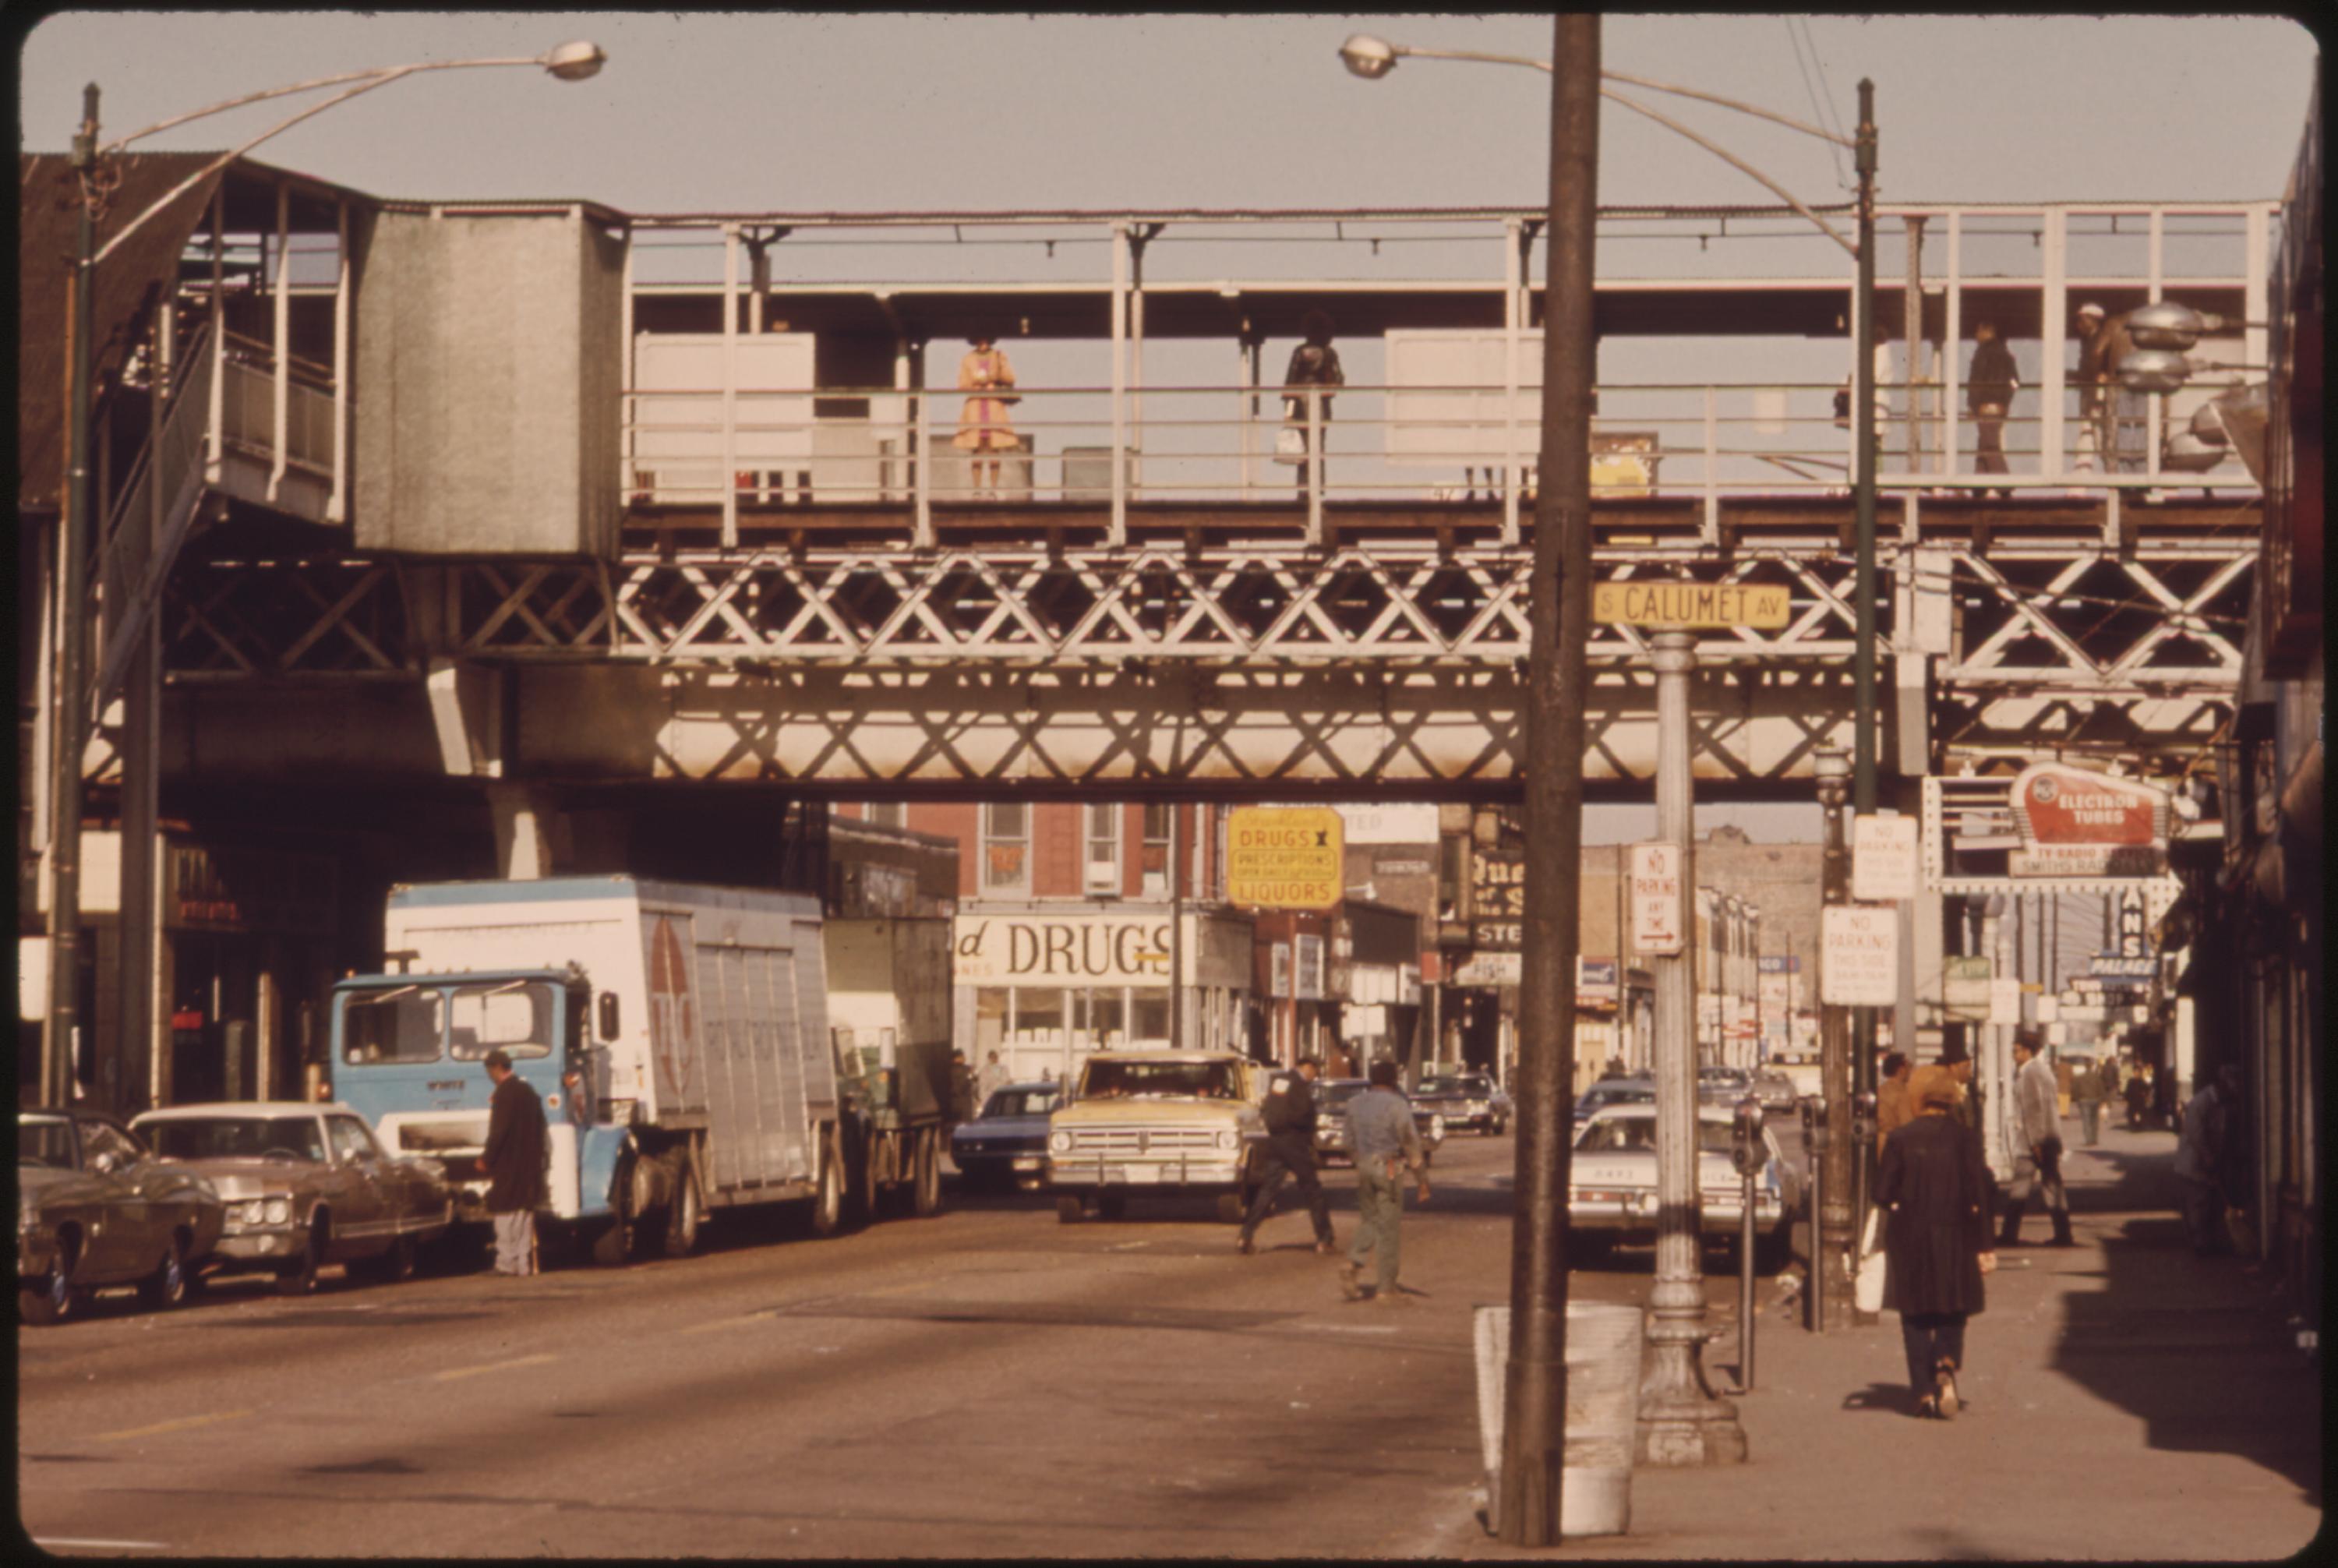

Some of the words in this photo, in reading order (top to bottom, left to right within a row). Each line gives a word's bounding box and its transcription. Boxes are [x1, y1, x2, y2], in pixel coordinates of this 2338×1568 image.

[1601, 593, 1612, 614] S
[1624, 586, 1750, 623] CALUMET
[1756, 596, 1782, 615] AV
[2058, 794, 2138, 808] ELECTRON
[2074, 810, 2125, 824] TUBES
[1240, 829, 1310, 847] DRUGS
[1875, 825, 1894, 838] NO
[1859, 841, 1911, 853] PARKING
[1648, 853, 1665, 874] NO
[1239, 884, 1330, 902] LIQUORS
[1637, 878, 1676, 897] PARKING
[1850, 916, 1870, 931] NO
[2121, 886, 2142, 957] ANS
[1007, 923, 1170, 976] DRUGS
[1829, 934, 1891, 951] PARKING
